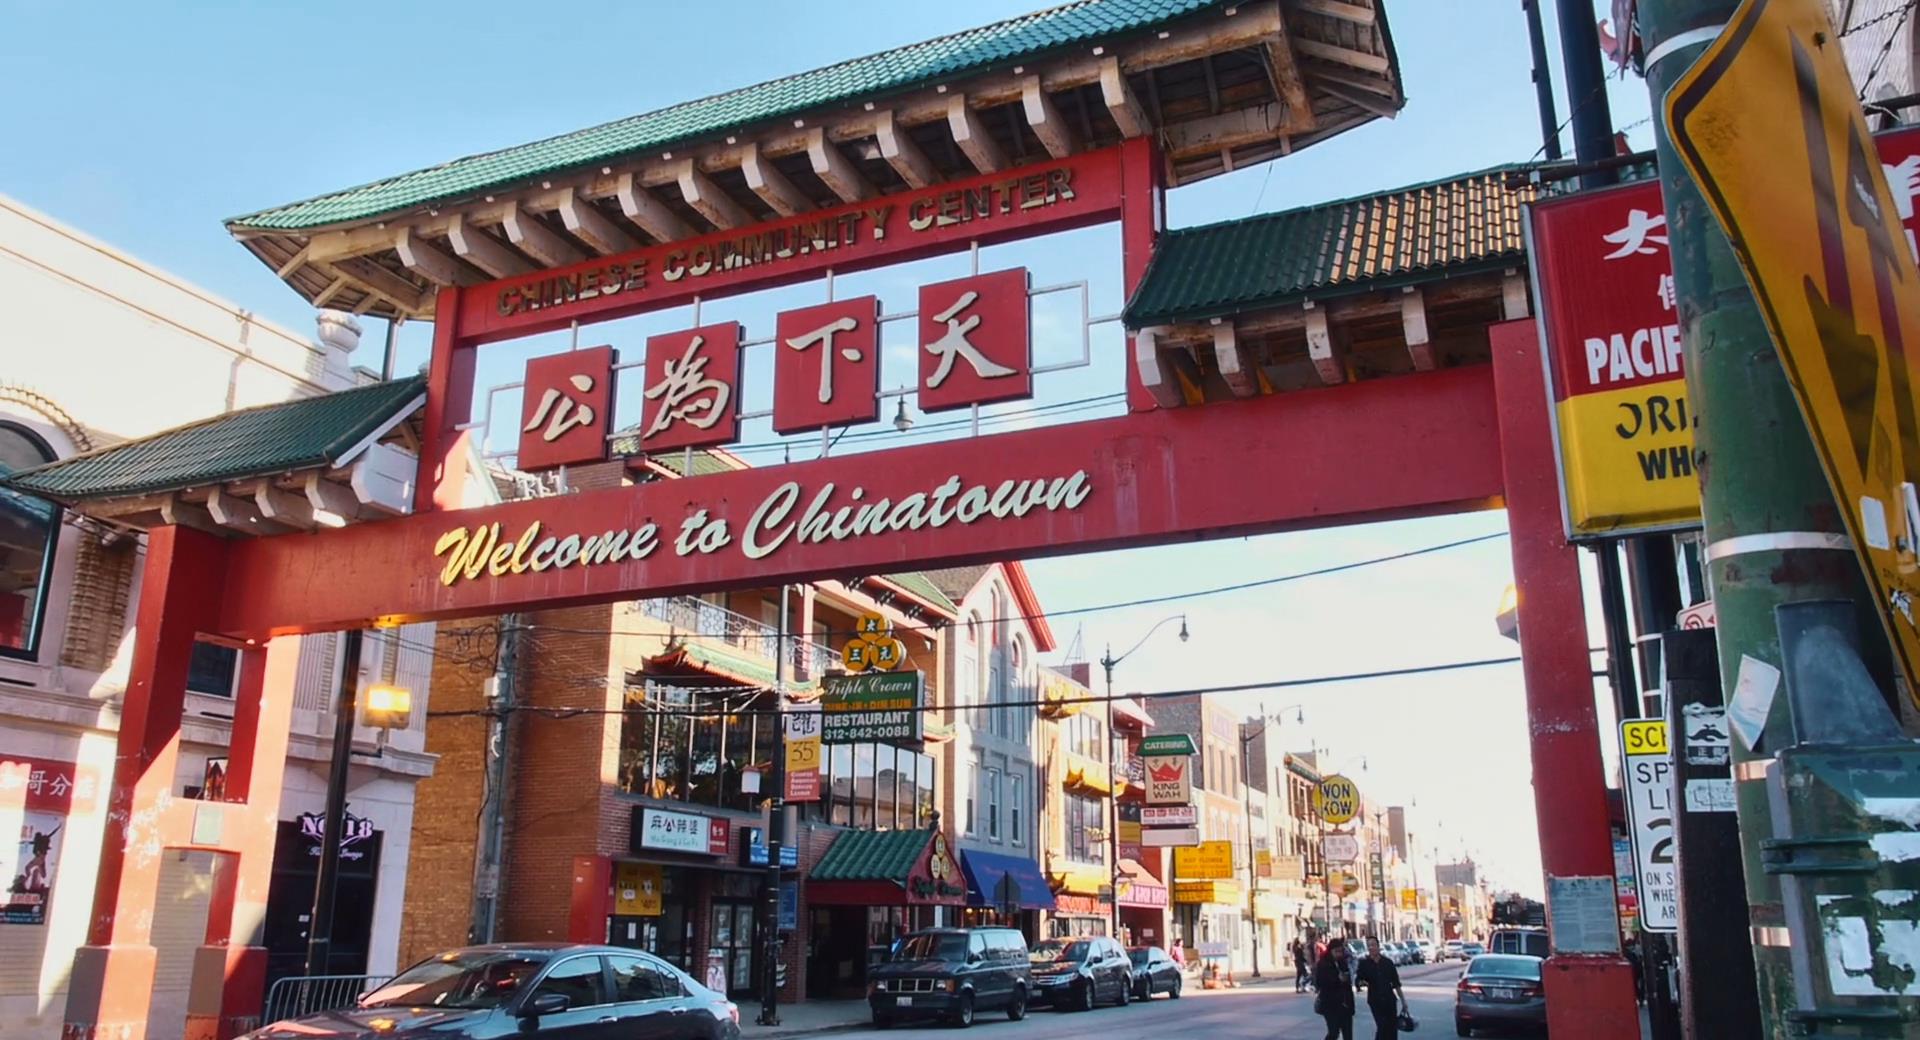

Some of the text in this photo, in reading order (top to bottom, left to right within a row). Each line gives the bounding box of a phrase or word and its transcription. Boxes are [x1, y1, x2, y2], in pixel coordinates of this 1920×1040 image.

[498, 167, 1077, 317] CHINESE COMMUNITY CENTER
[524, 291, 1018, 442] 公 為 下 天
[1637, 445, 1697, 481] WH
[435, 469, 1091, 588] Welcome to Chinatown
[825, 676, 912, 700] Triple Crown
[824, 711, 910, 727] RESTAURANT
[792, 740, 814, 762] 35
[1144, 740, 1188, 750] CATERING
[1636, 762, 1674, 784] SP
[1153, 782, 1180, 791] KING
[1153, 791, 1181, 799] WAH
[1646, 871, 1662, 886] ON
